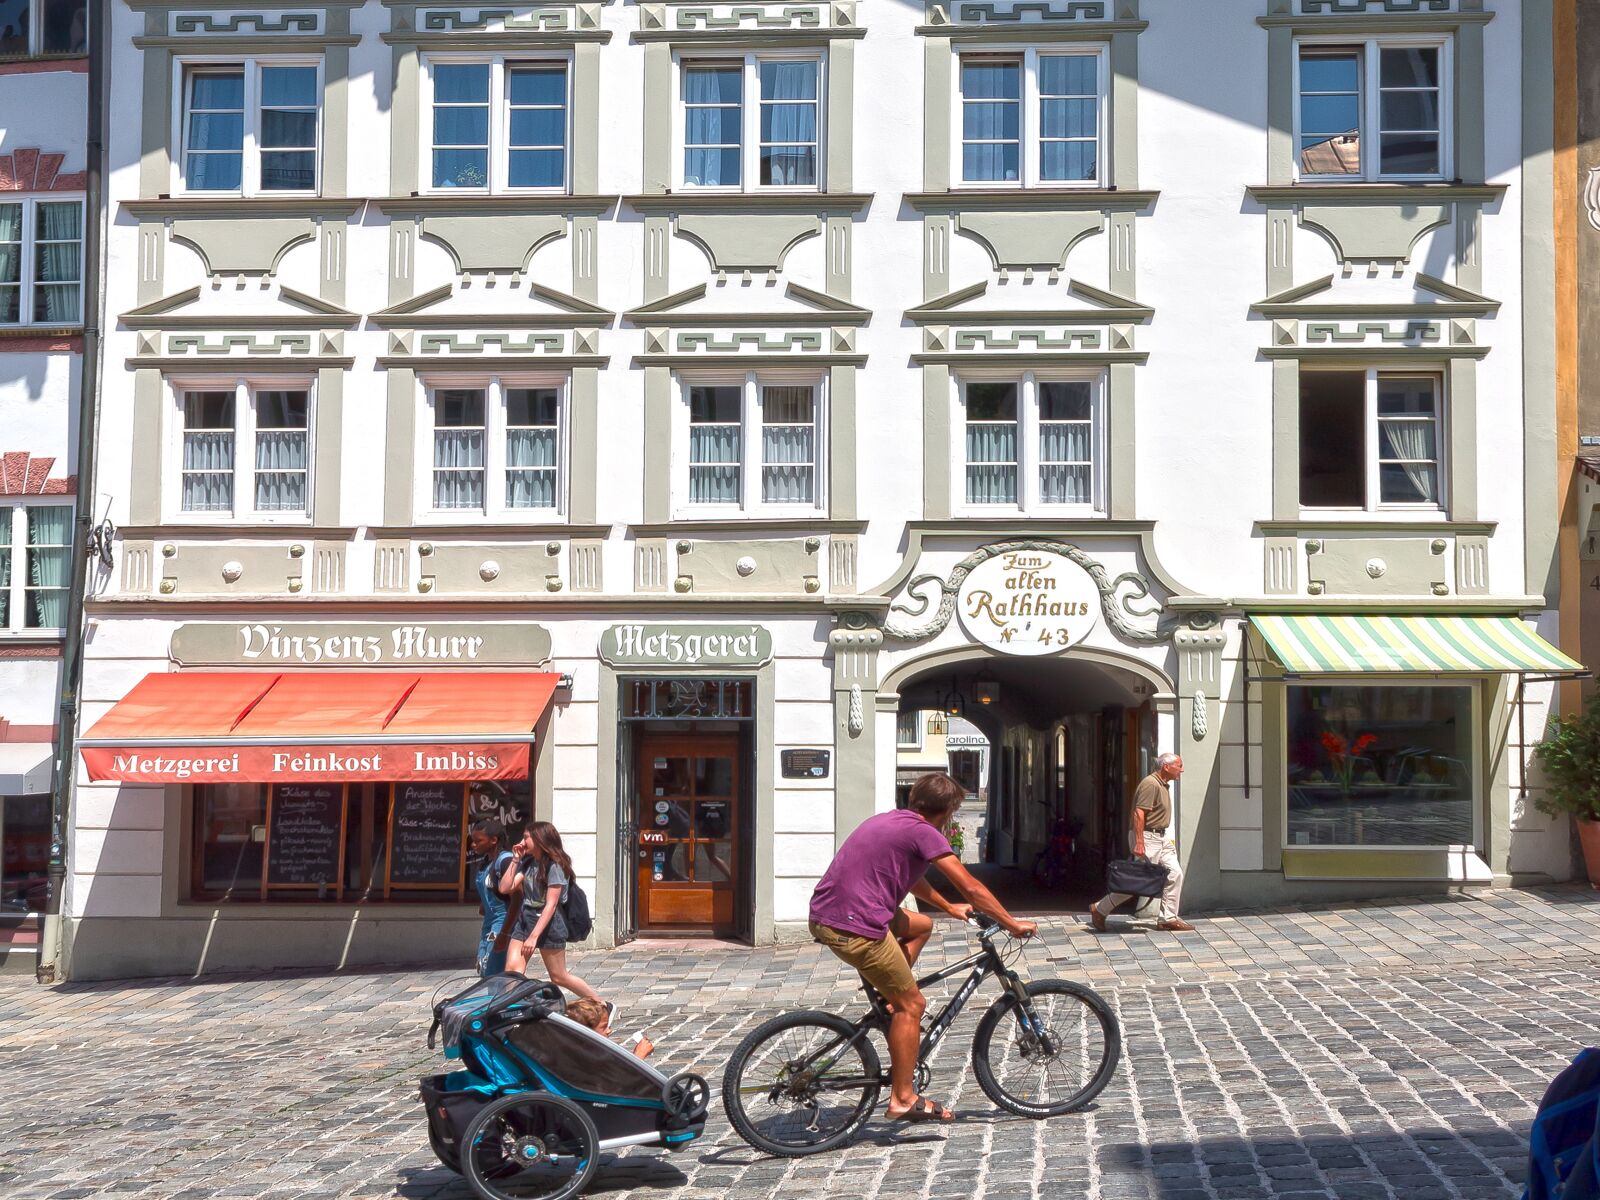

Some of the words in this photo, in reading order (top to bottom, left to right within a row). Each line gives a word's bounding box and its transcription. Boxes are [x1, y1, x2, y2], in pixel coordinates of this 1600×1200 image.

[1003, 554, 1051, 570] Zum
[1005, 571, 1056, 589] alten
[967, 590, 1089, 627] Rathhaus
[240, 624, 382, 663] Vinzenz
[391, 626, 484, 659] Murr
[614, 625, 759, 662] Metzgerei
[1038, 628, 1069, 646] 43
[112, 752, 240, 778] Metzgerei
[272, 751, 383, 772] Feinkost
[413, 750, 498, 770] Imbiss
[643, 833, 664, 842] vm
